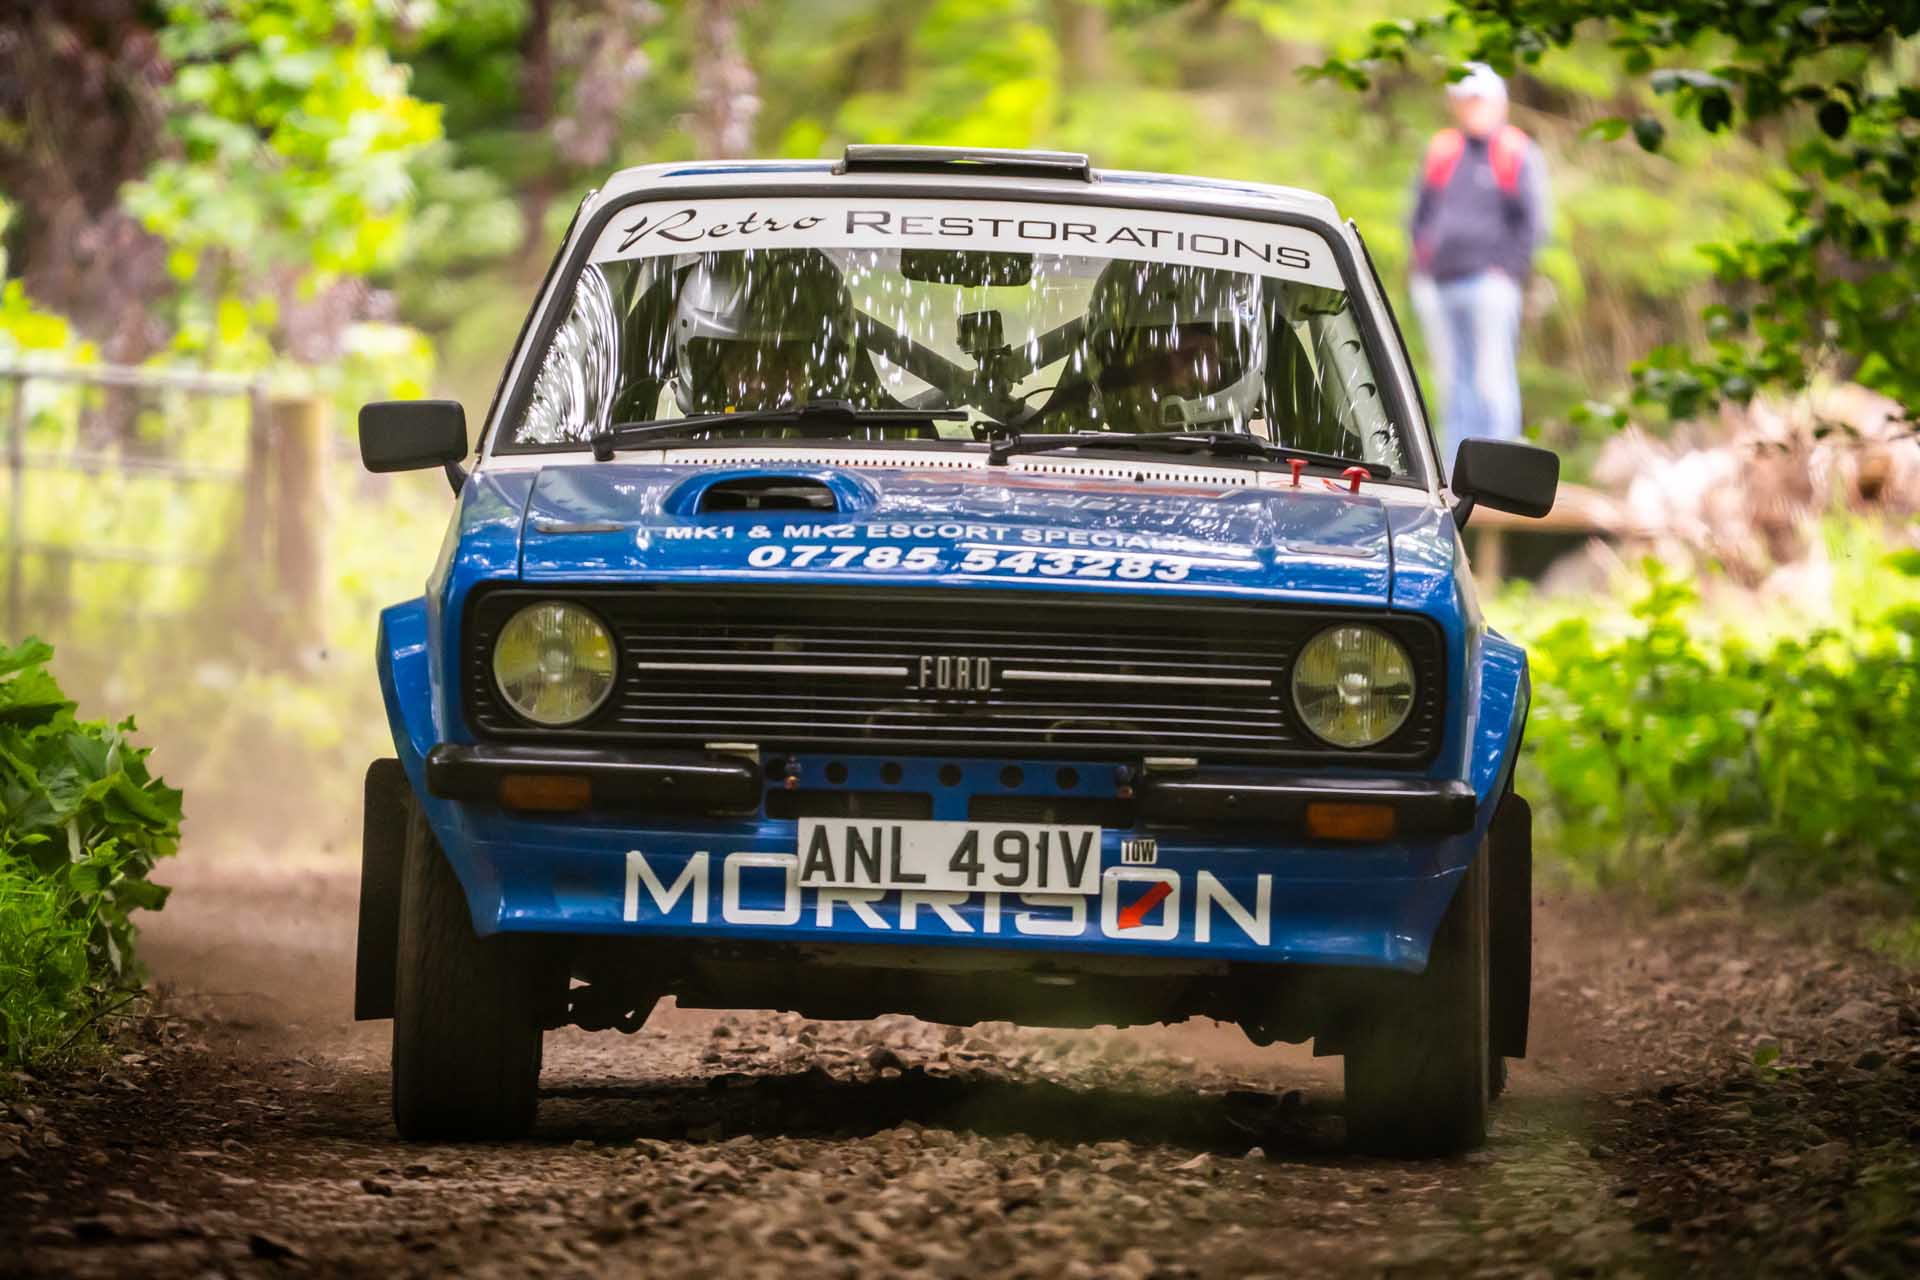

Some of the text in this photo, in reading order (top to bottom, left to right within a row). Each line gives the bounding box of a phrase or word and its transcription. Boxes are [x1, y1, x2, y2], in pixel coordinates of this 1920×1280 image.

[617, 208, 1311, 270] Retro RESTORATIONS
[664, 525, 735, 540] MK1
[747, 525, 772, 539] &
[782, 524, 856, 539] MK2
[866, 524, 1011, 541] ESCORT
[747, 545, 1191, 582] 07785 543283
[920, 655, 991, 690] FORD
[801, 824, 1094, 888] ANL 491V
[1124, 840, 1155, 862] TOW
